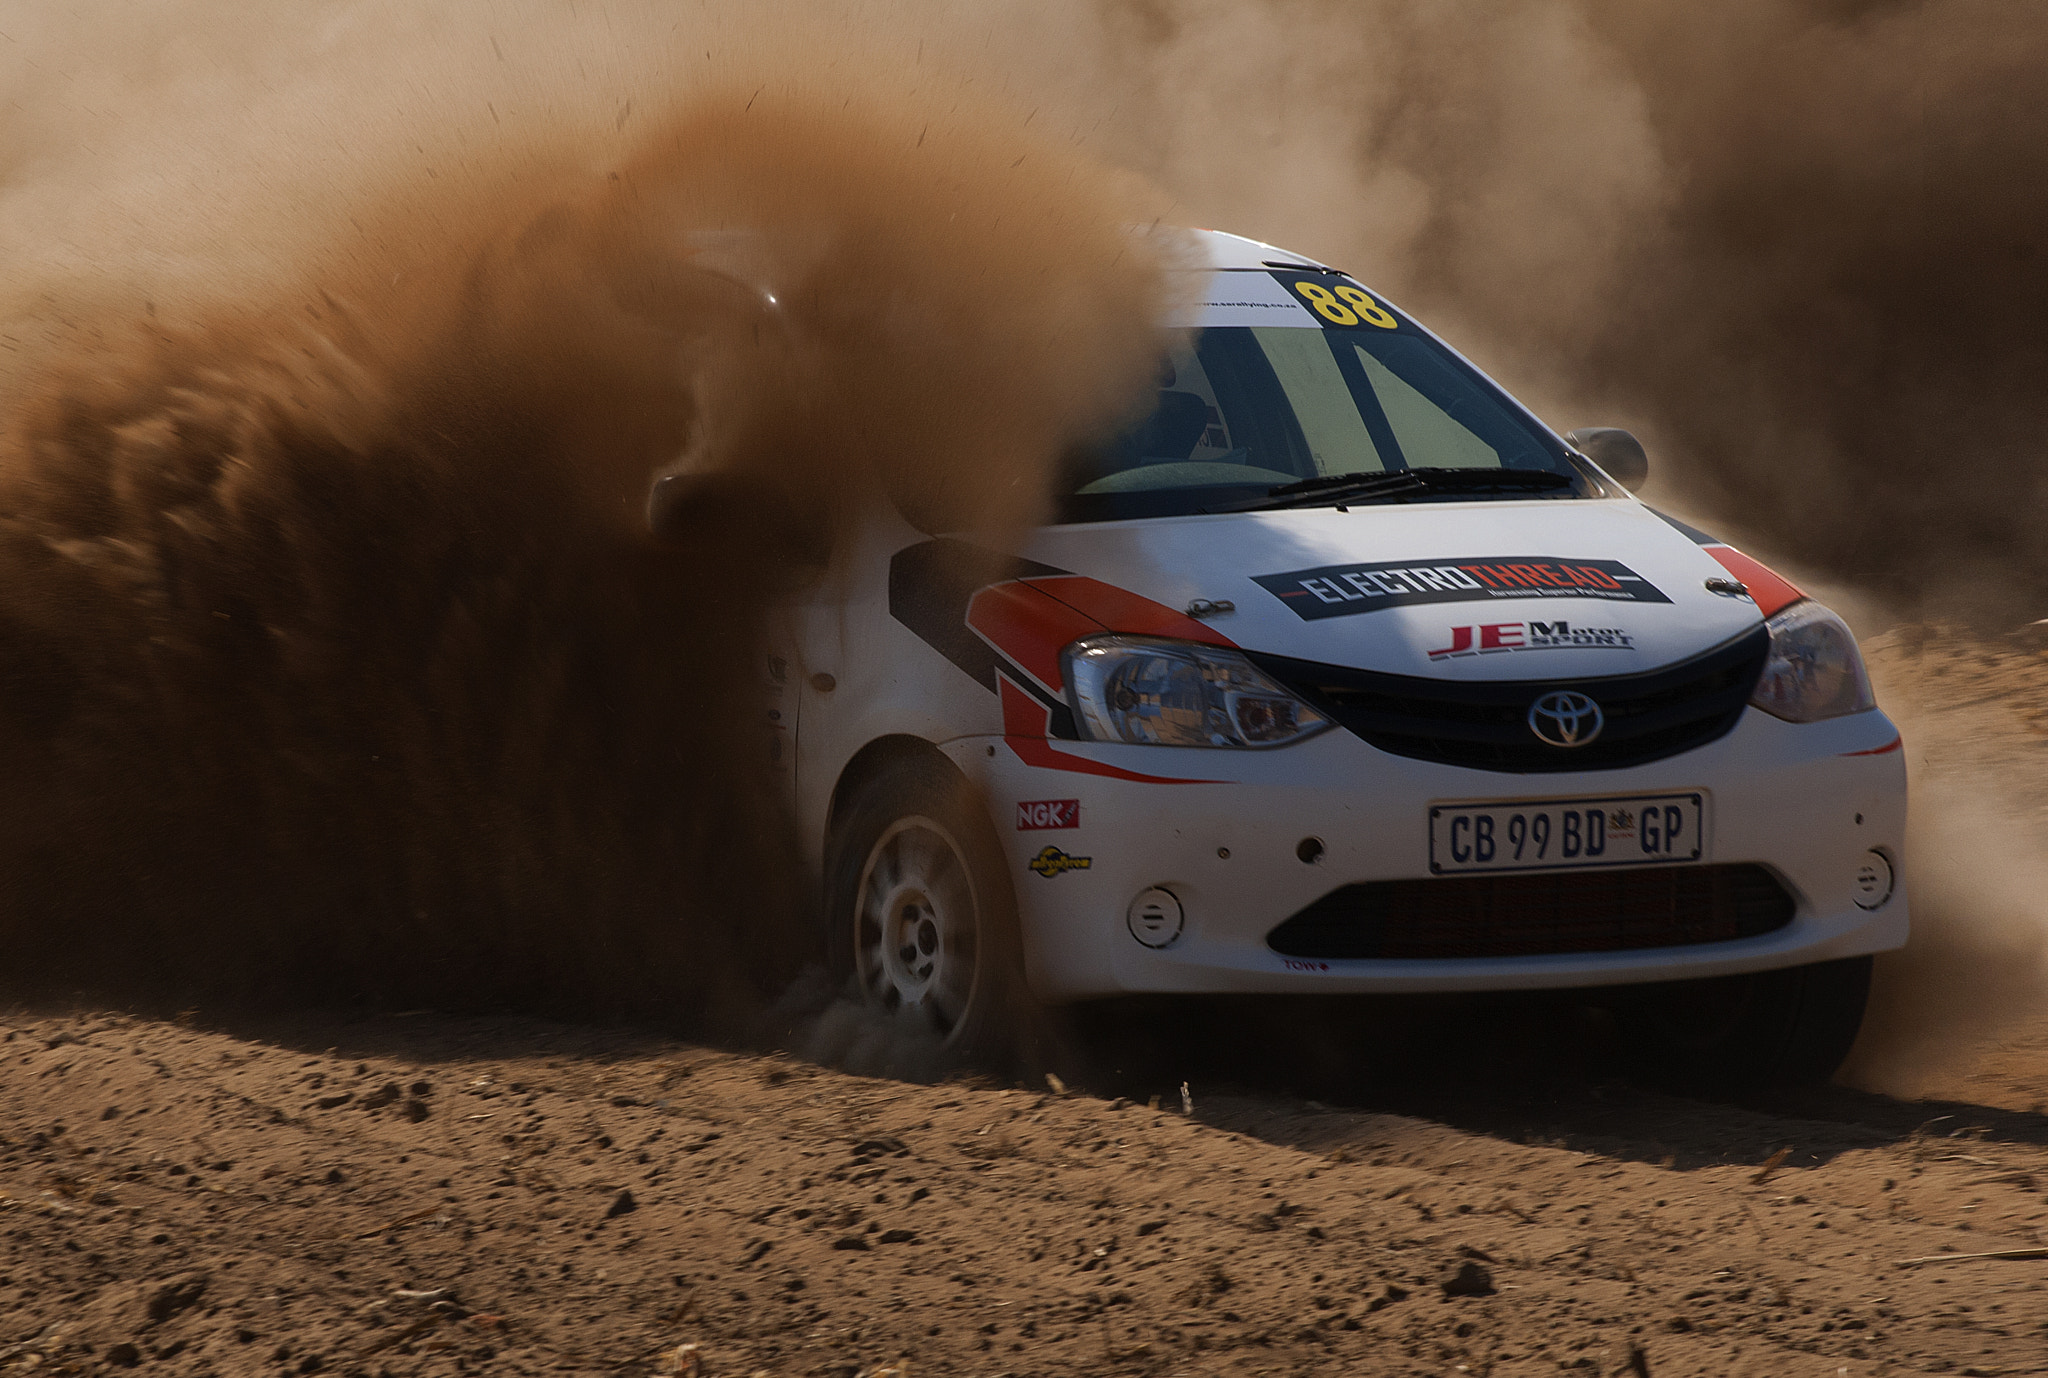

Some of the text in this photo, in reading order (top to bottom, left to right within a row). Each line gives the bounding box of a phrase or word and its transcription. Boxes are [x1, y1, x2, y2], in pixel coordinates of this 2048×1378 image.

[1295, 281, 1398, 330] 88
[1427, 622, 1525, 656] JE
[1018, 802, 1064, 828] NGK
[1451, 805, 1683, 863] CB 99 BD GP
[1283, 959, 1318, 971] TOW
